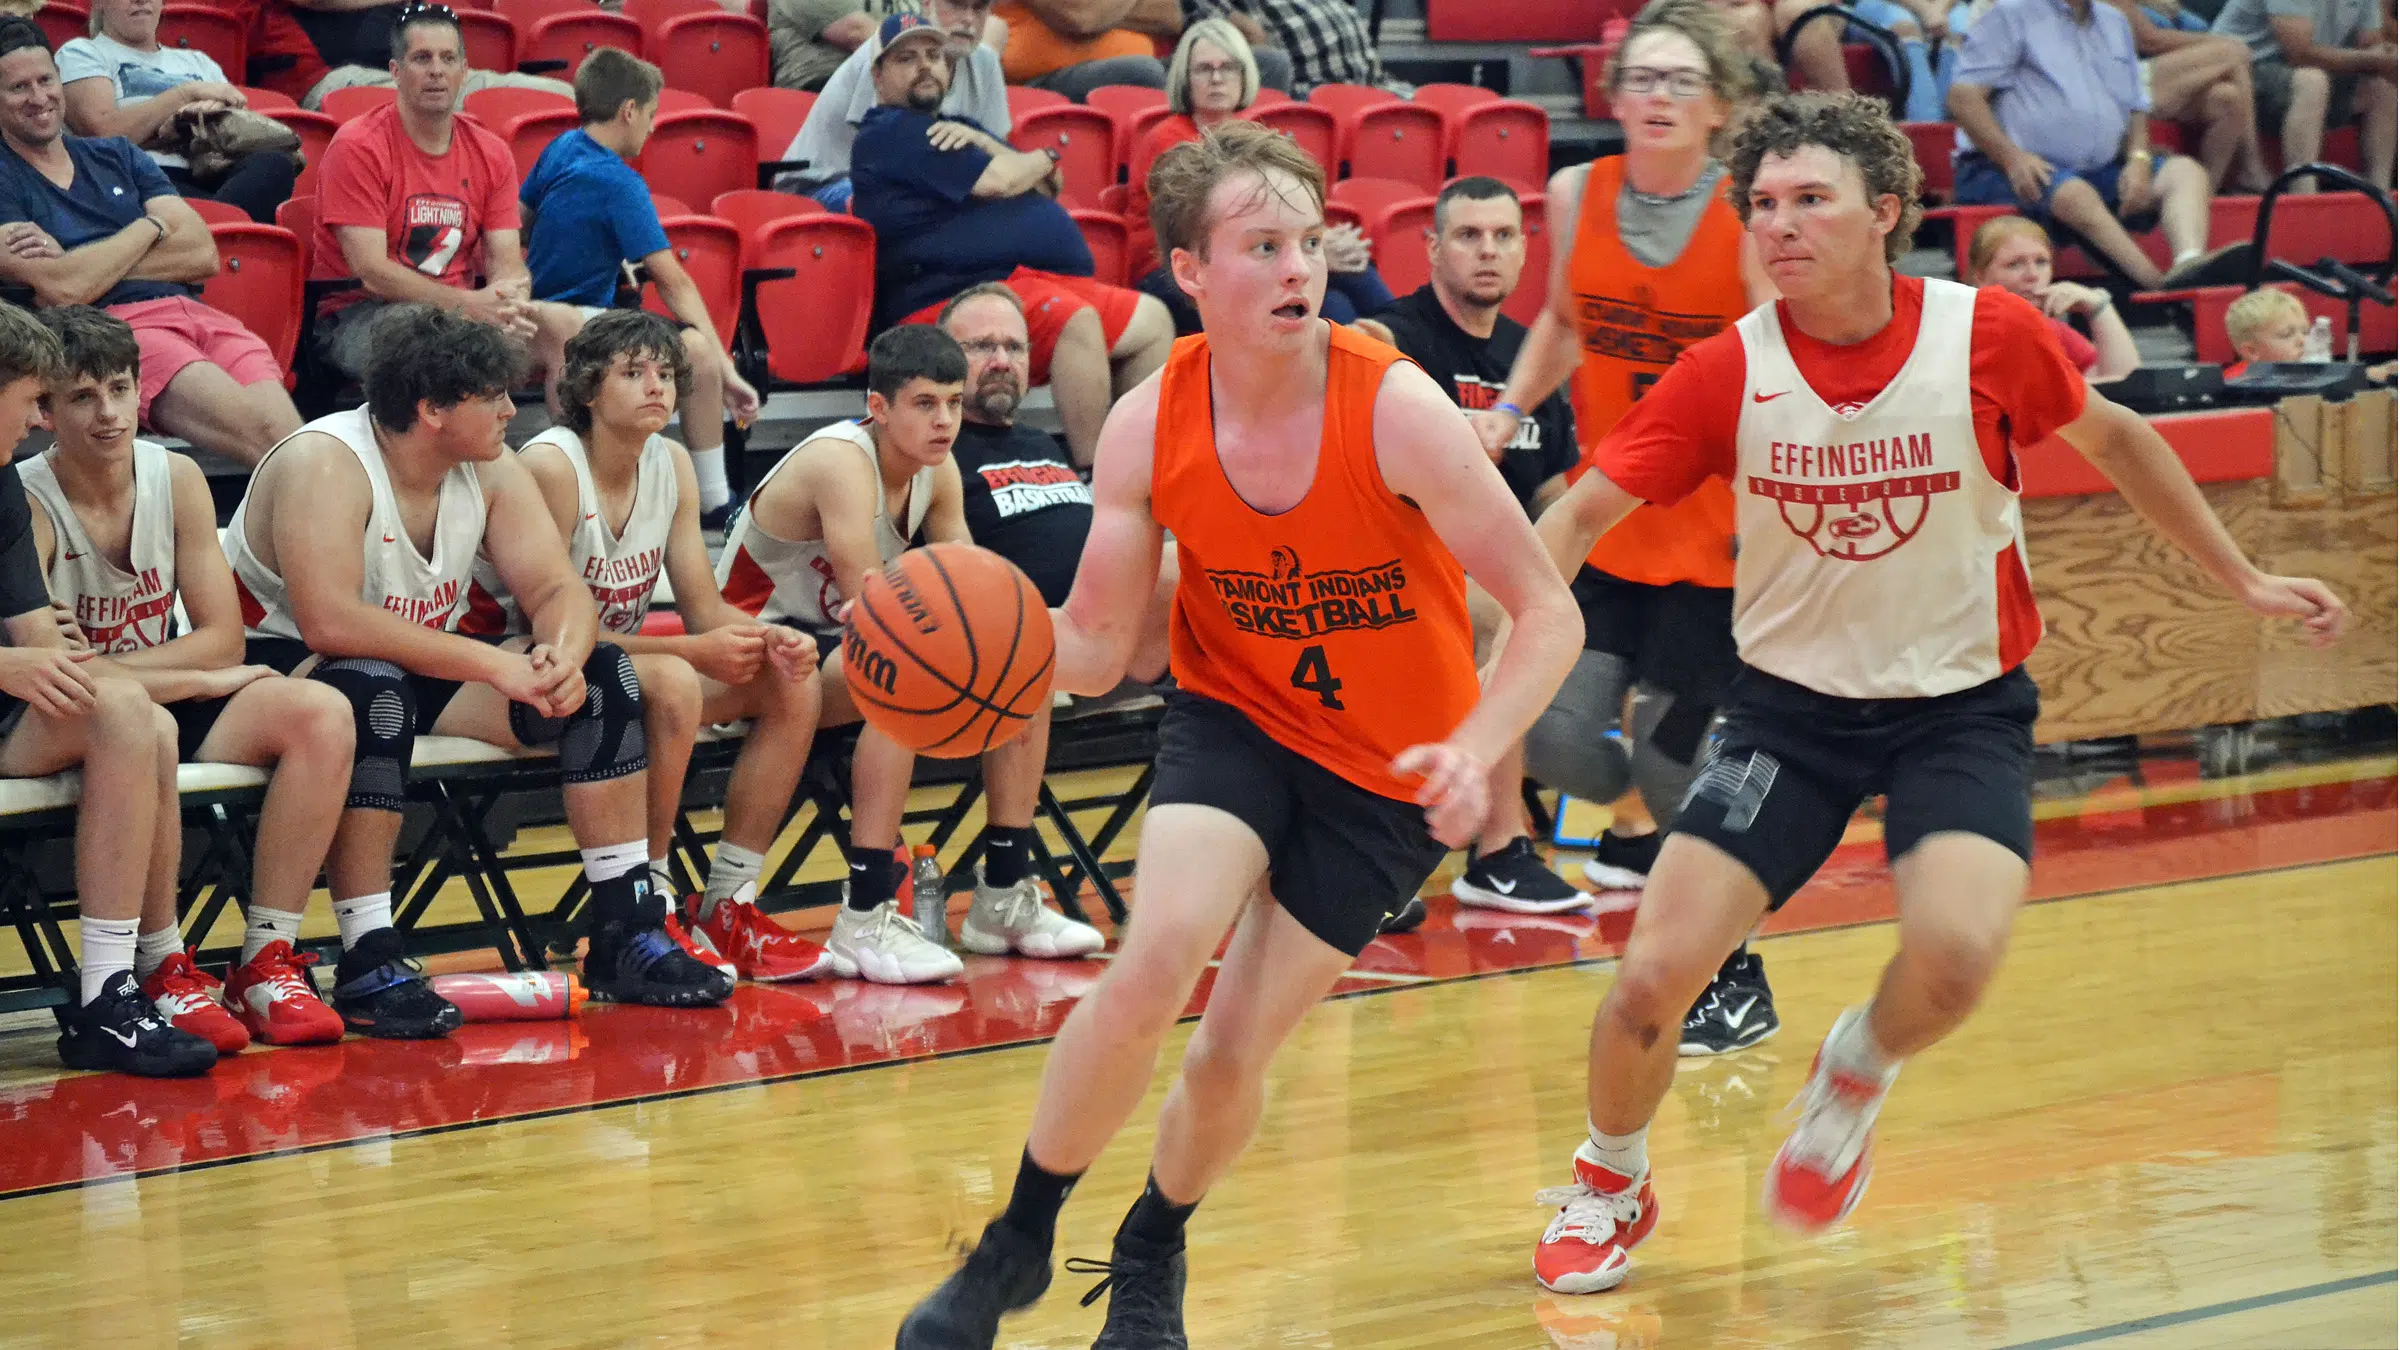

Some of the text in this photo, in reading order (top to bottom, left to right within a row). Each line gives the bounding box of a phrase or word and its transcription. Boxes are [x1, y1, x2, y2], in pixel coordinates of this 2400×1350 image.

[410, 206, 463, 229] LIGHTNING
[1771, 432, 1933, 477] EFFINGHAM
[981, 465, 1080, 490] EFFINGH
[1756, 475, 1952, 501] BASKETBALL
[992, 485, 1093, 518] BASKETBA
[76, 568, 162, 621] EFFINAM
[1309, 567, 1406, 602] INDIANS
[1290, 644, 1345, 711] 4
